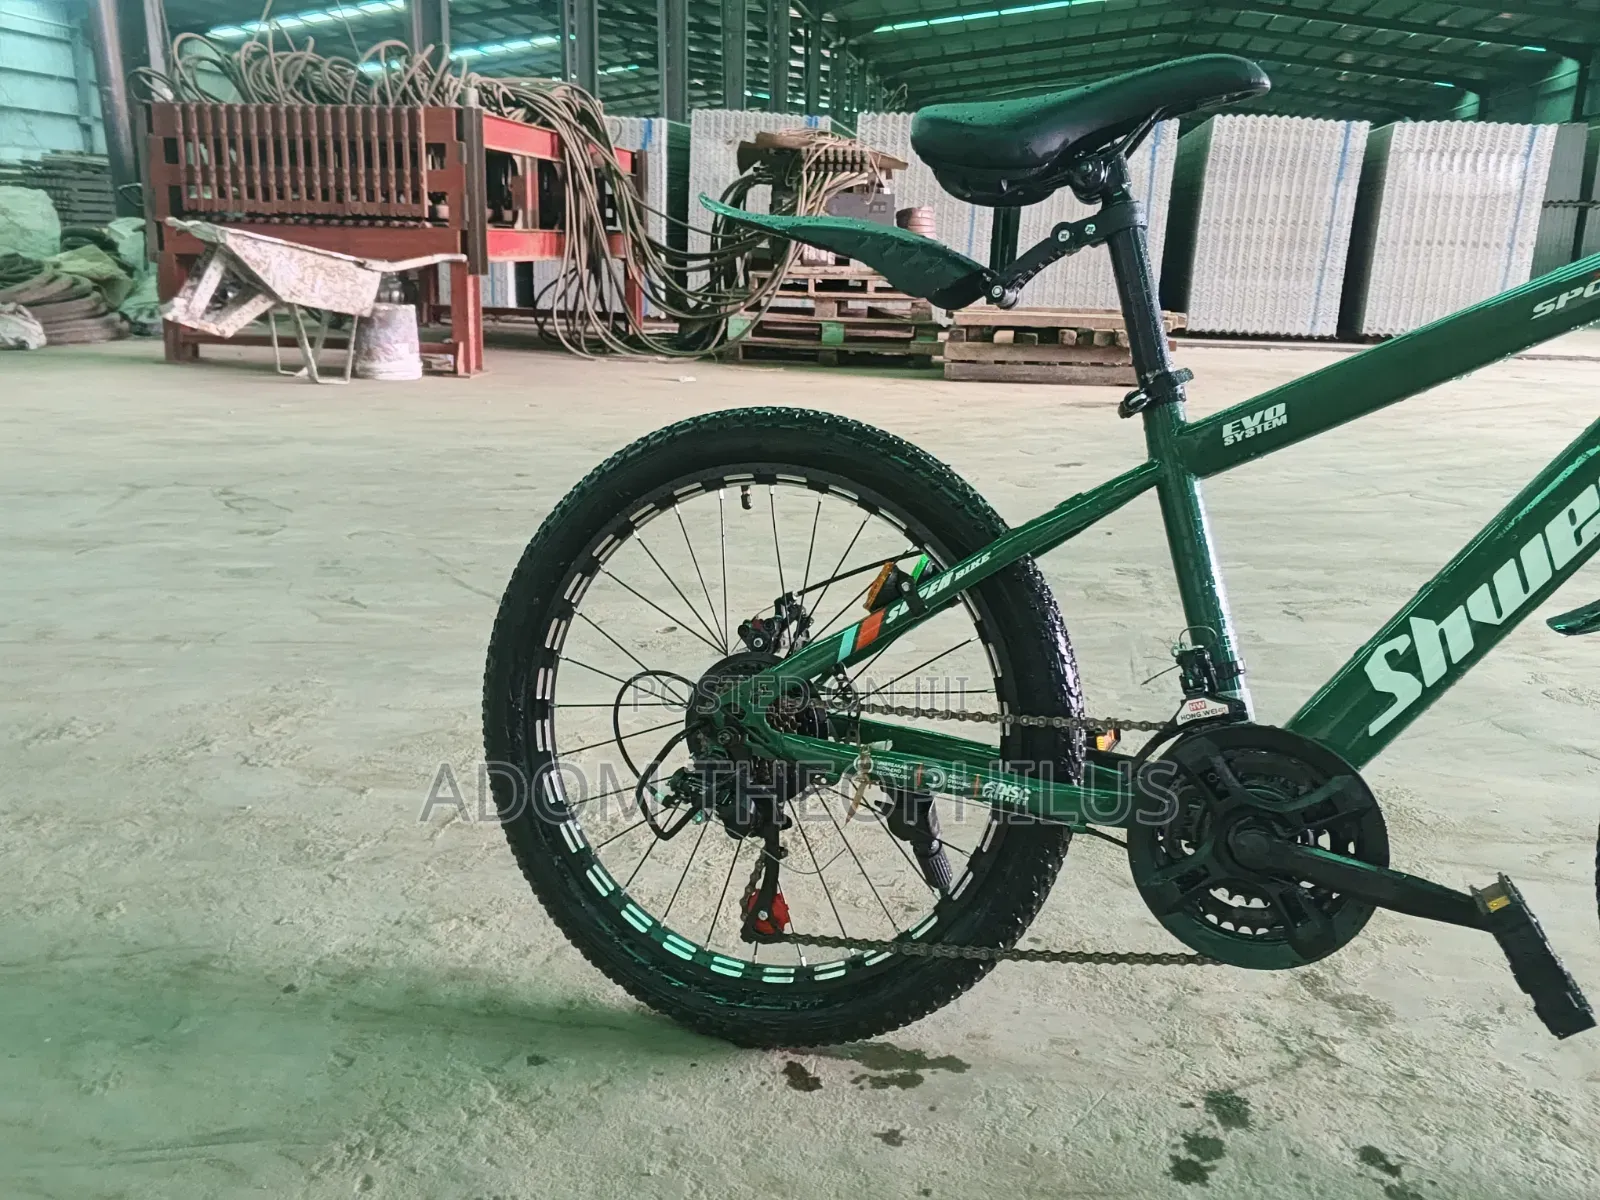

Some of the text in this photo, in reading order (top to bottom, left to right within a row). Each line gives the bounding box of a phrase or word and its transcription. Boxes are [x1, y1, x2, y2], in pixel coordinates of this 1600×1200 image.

[1222, 402, 1286, 438] EVO
[1223, 414, 1287, 446] SYSTEM
[953, 551, 991, 581] BIKE
[1180, 712, 1202, 721] HONG
[1189, 701, 1206, 711] HW
